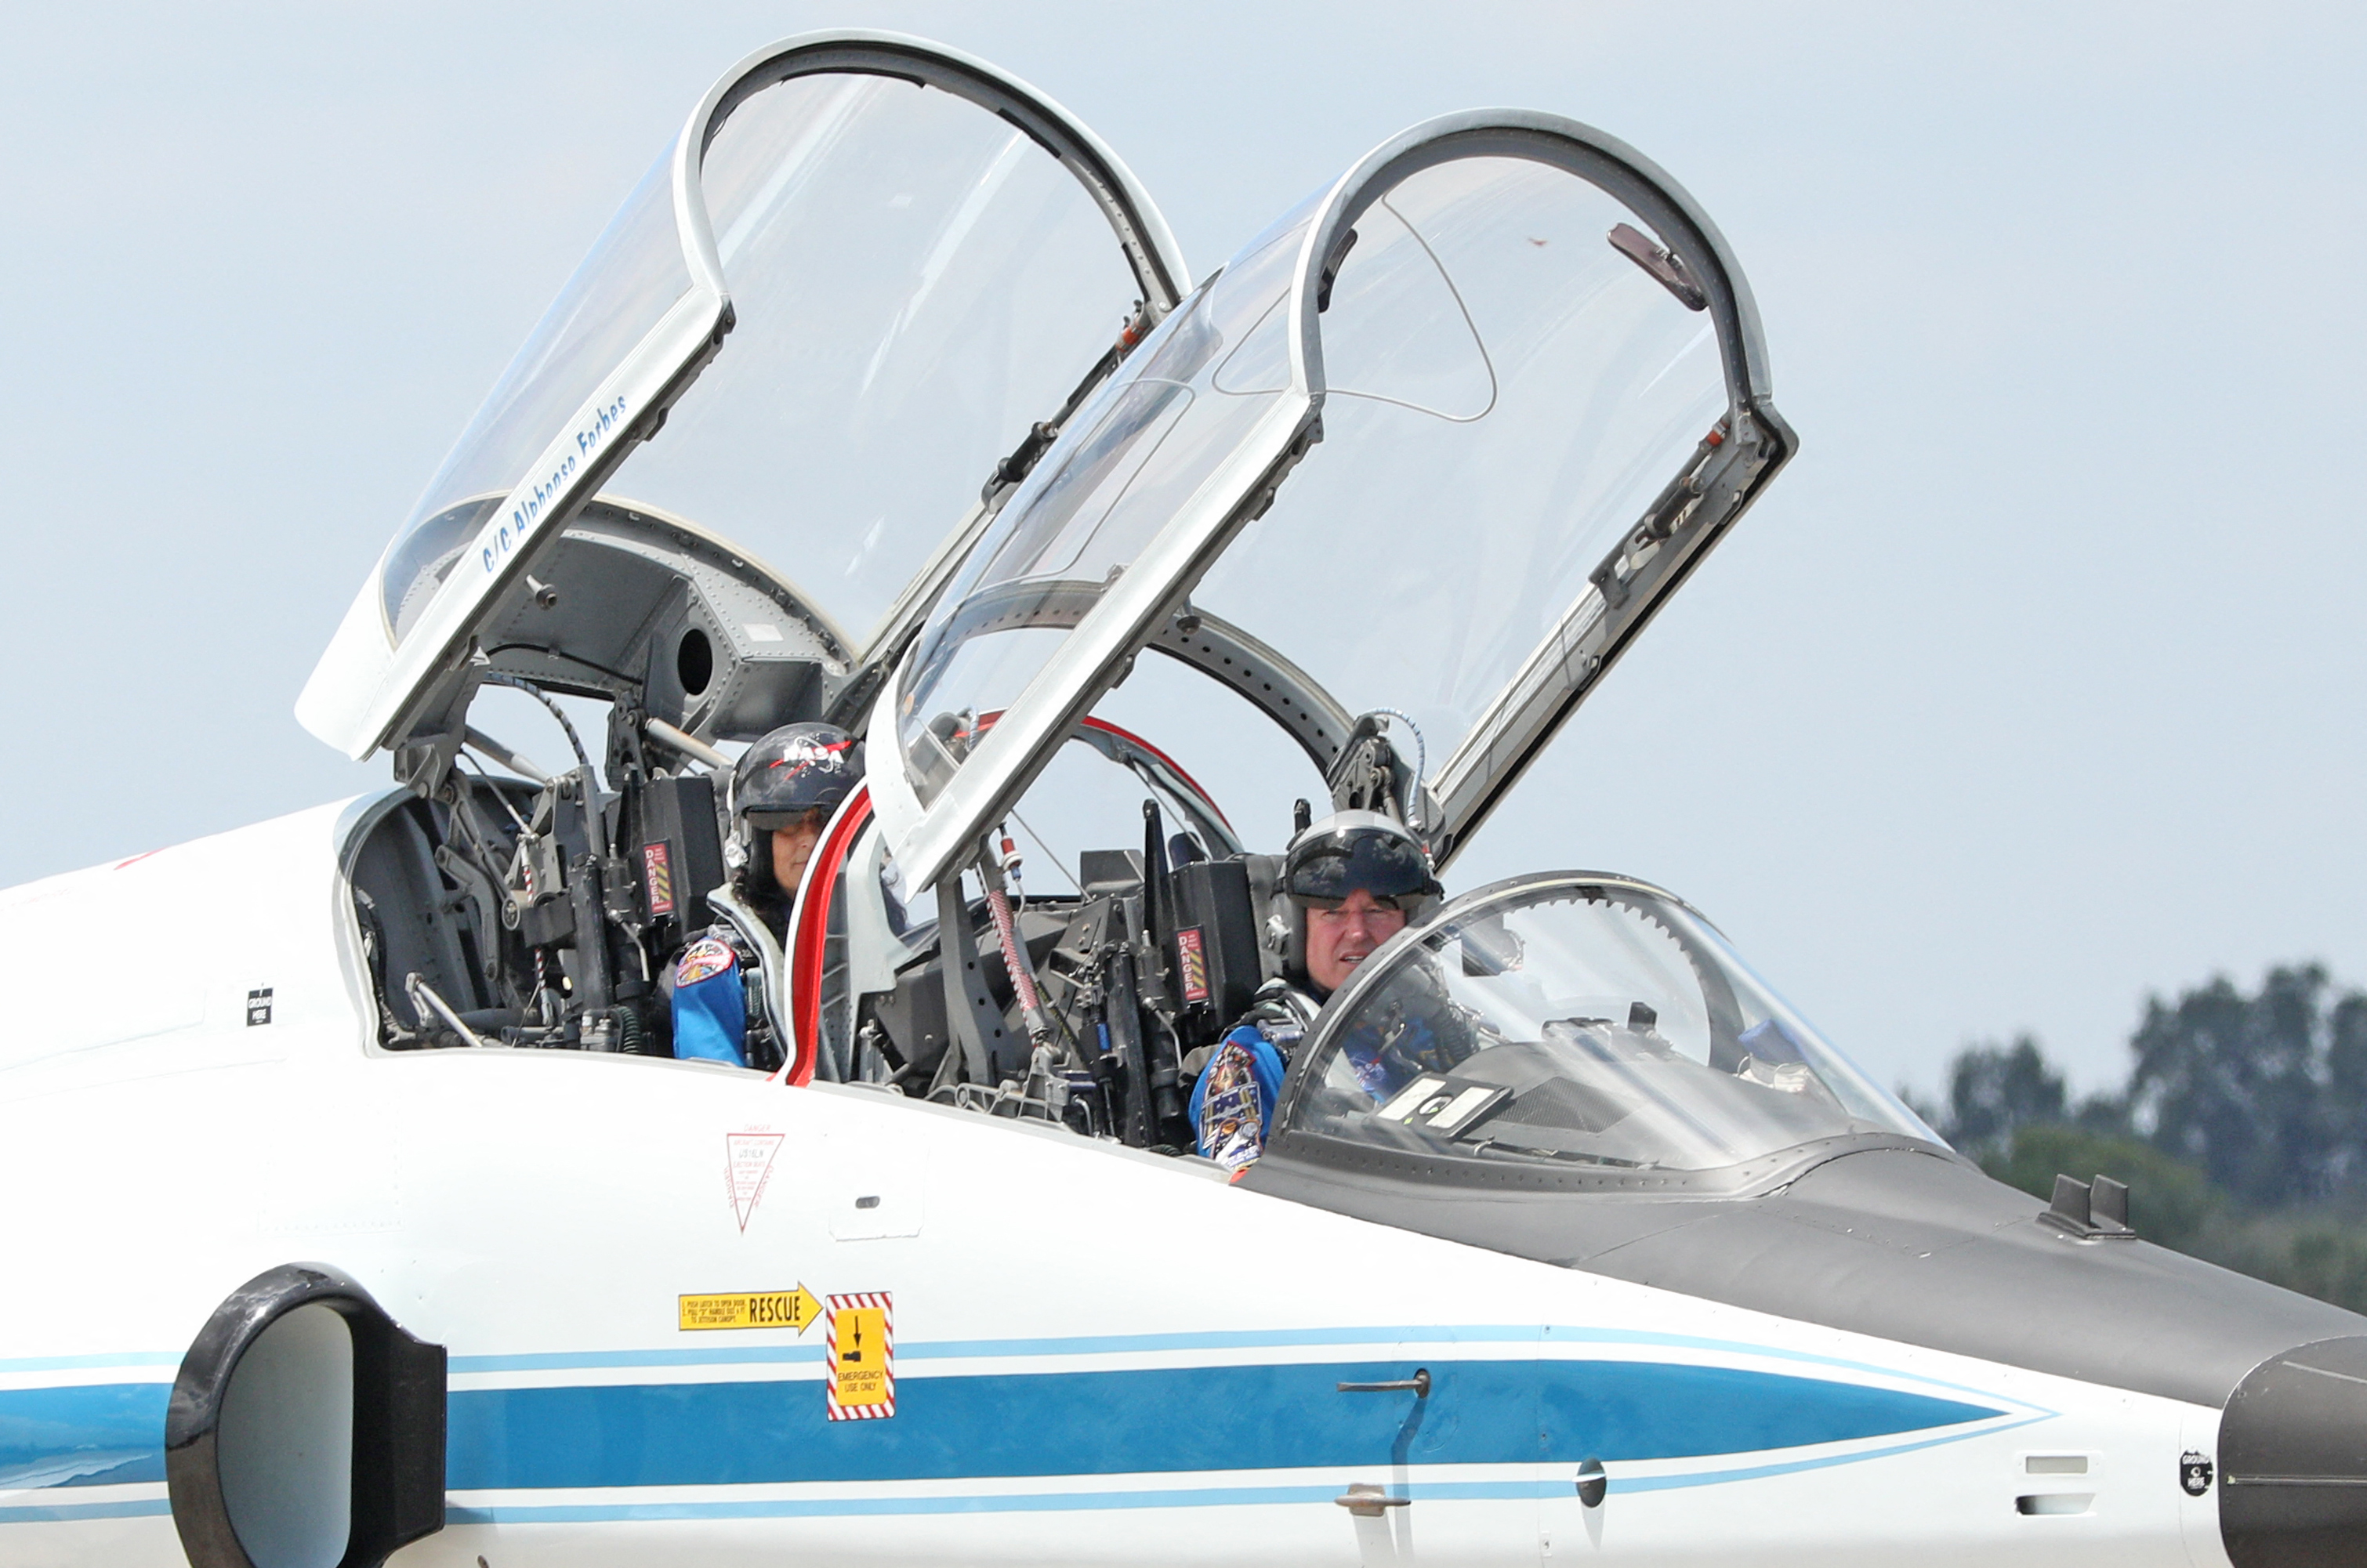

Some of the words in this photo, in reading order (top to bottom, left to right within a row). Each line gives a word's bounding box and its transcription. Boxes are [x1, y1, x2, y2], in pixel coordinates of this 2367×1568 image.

[482, 527, 511, 574] C/C
[513, 455, 576, 538] Alphonso
[576, 395, 626, 458] Forbes
[782, 745, 845, 764] NASA
[644, 849, 660, 905] DANGER
[1178, 936, 1194, 993] DANGER
[749, 1295, 800, 1322] RESCUE
[838, 1370, 883, 1382] EMERGENCY
[844, 1382, 858, 1392] USE
[860, 1382, 876, 1392] ONLY
